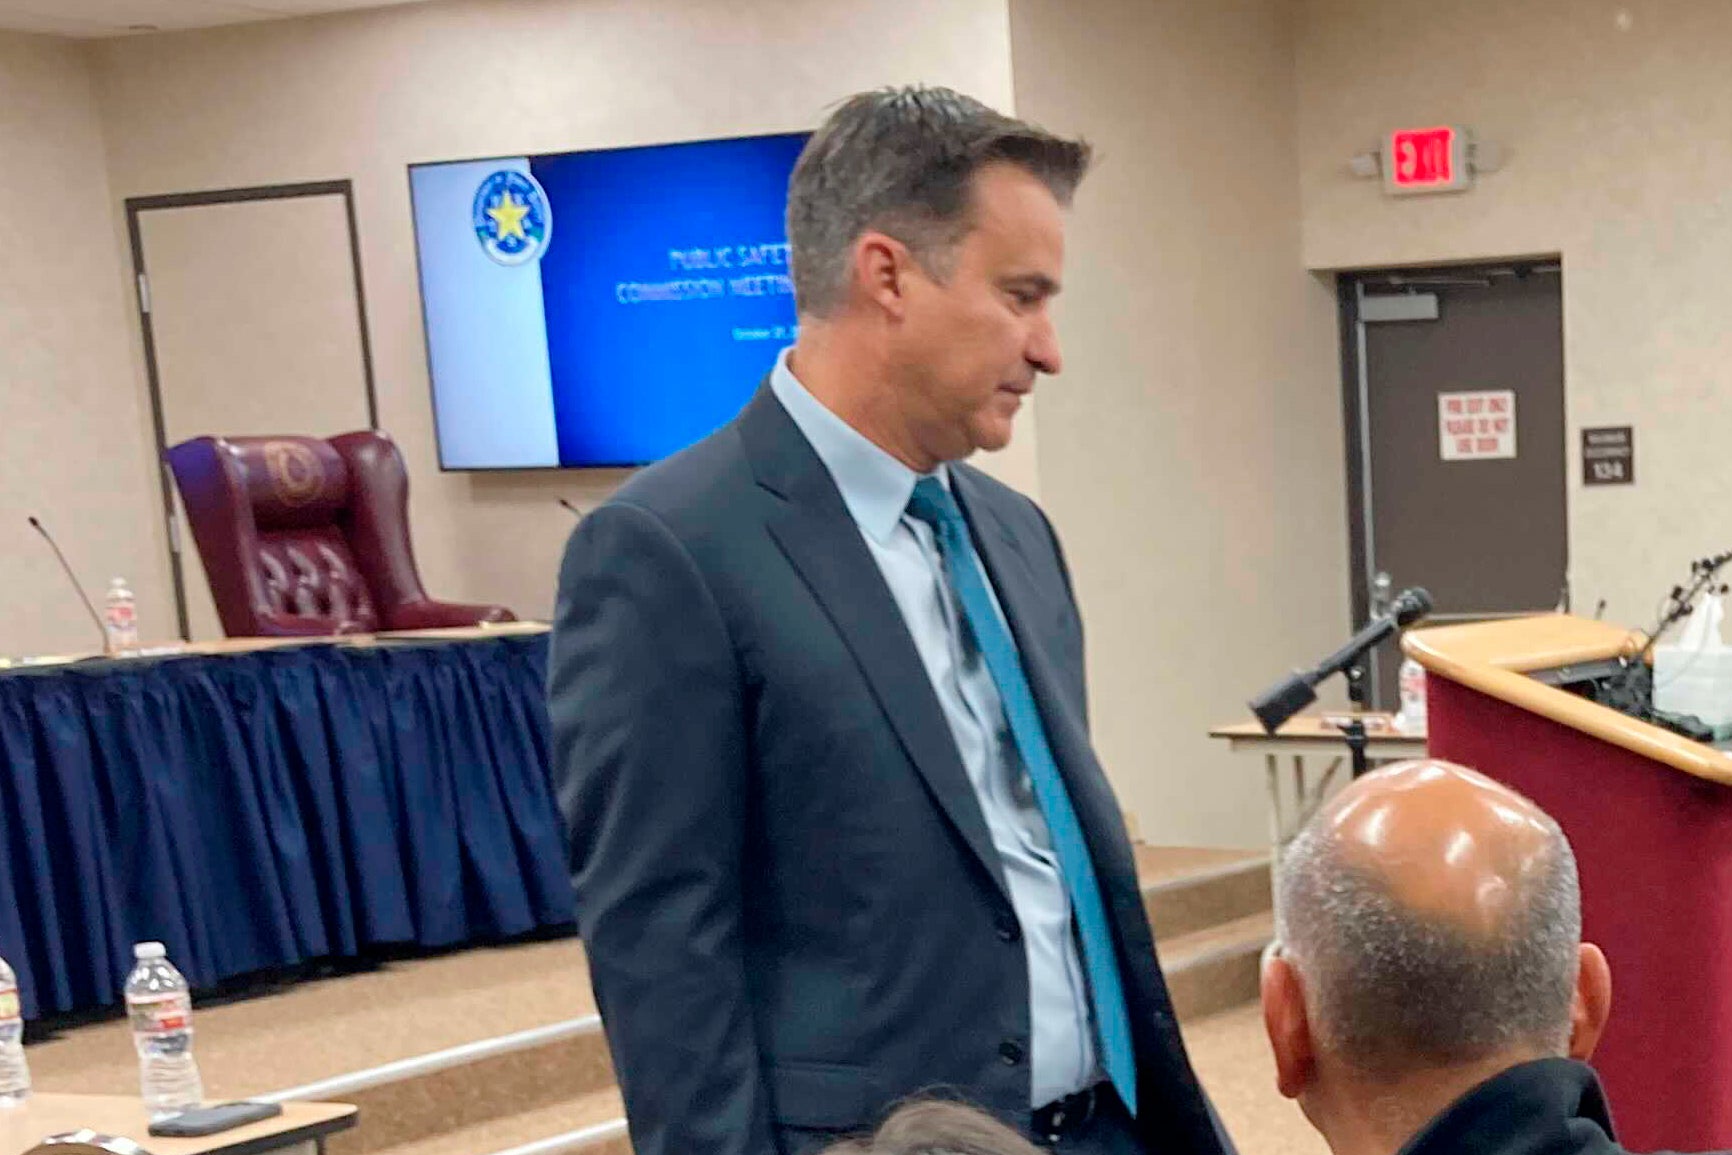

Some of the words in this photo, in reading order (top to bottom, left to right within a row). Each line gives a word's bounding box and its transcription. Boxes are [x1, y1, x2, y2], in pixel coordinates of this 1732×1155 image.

[667, 247, 733, 271] PUBLIC
[736, 243, 792, 267] SAFET
[729, 274, 796, 297] MEETIN
